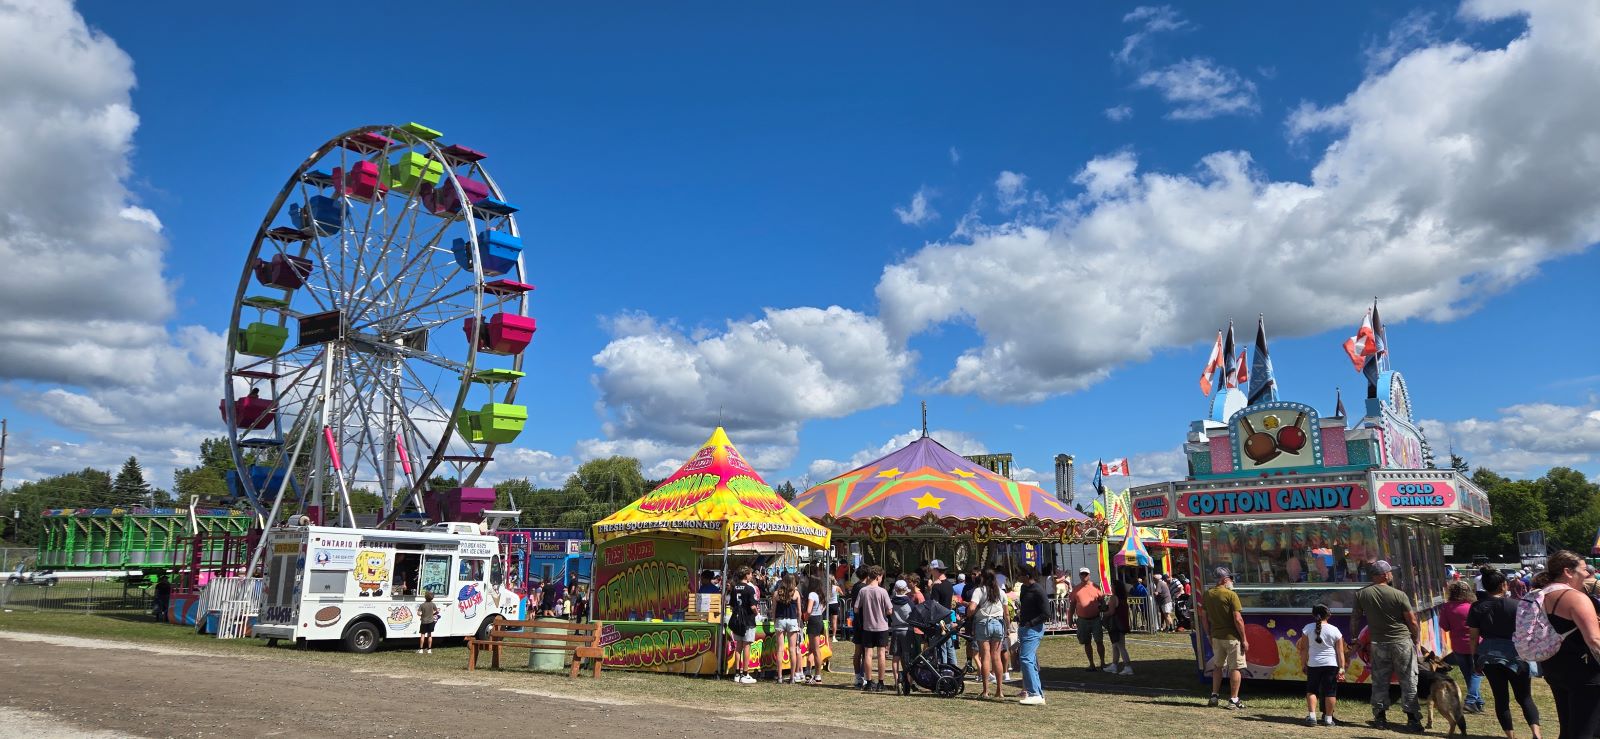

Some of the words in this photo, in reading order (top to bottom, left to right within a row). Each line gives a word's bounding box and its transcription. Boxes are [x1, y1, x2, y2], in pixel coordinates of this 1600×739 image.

[638, 473, 720, 512] LEMONADE
[1397, 483, 1435, 495] COLD
[1187, 492, 1270, 516] COTTON
[1277, 486, 1352, 511] CANDY
[1391, 495, 1444, 507] DRINKS
[1140, 508, 1163, 518] CORN
[598, 523, 624, 533] FRESH
[626, 520, 669, 530] SQUEEZED
[671, 520, 721, 531] LEMONADE
[733, 522, 757, 531] FRESH
[758, 522, 793, 534] SQUEEZED
[793, 524, 828, 537] LEMONADE
[321, 539, 353, 548] ONTARIO
[355, 541, 367, 549] ICE
[369, 541, 394, 549] CREAM
[626, 541, 656, 561] SQUEEZED
[605, 547, 625, 566] FRESH
[598, 559, 691, 619] LEMONADE
[458, 591, 484, 612] SLUSH
[603, 630, 711, 667] LEMONADE
